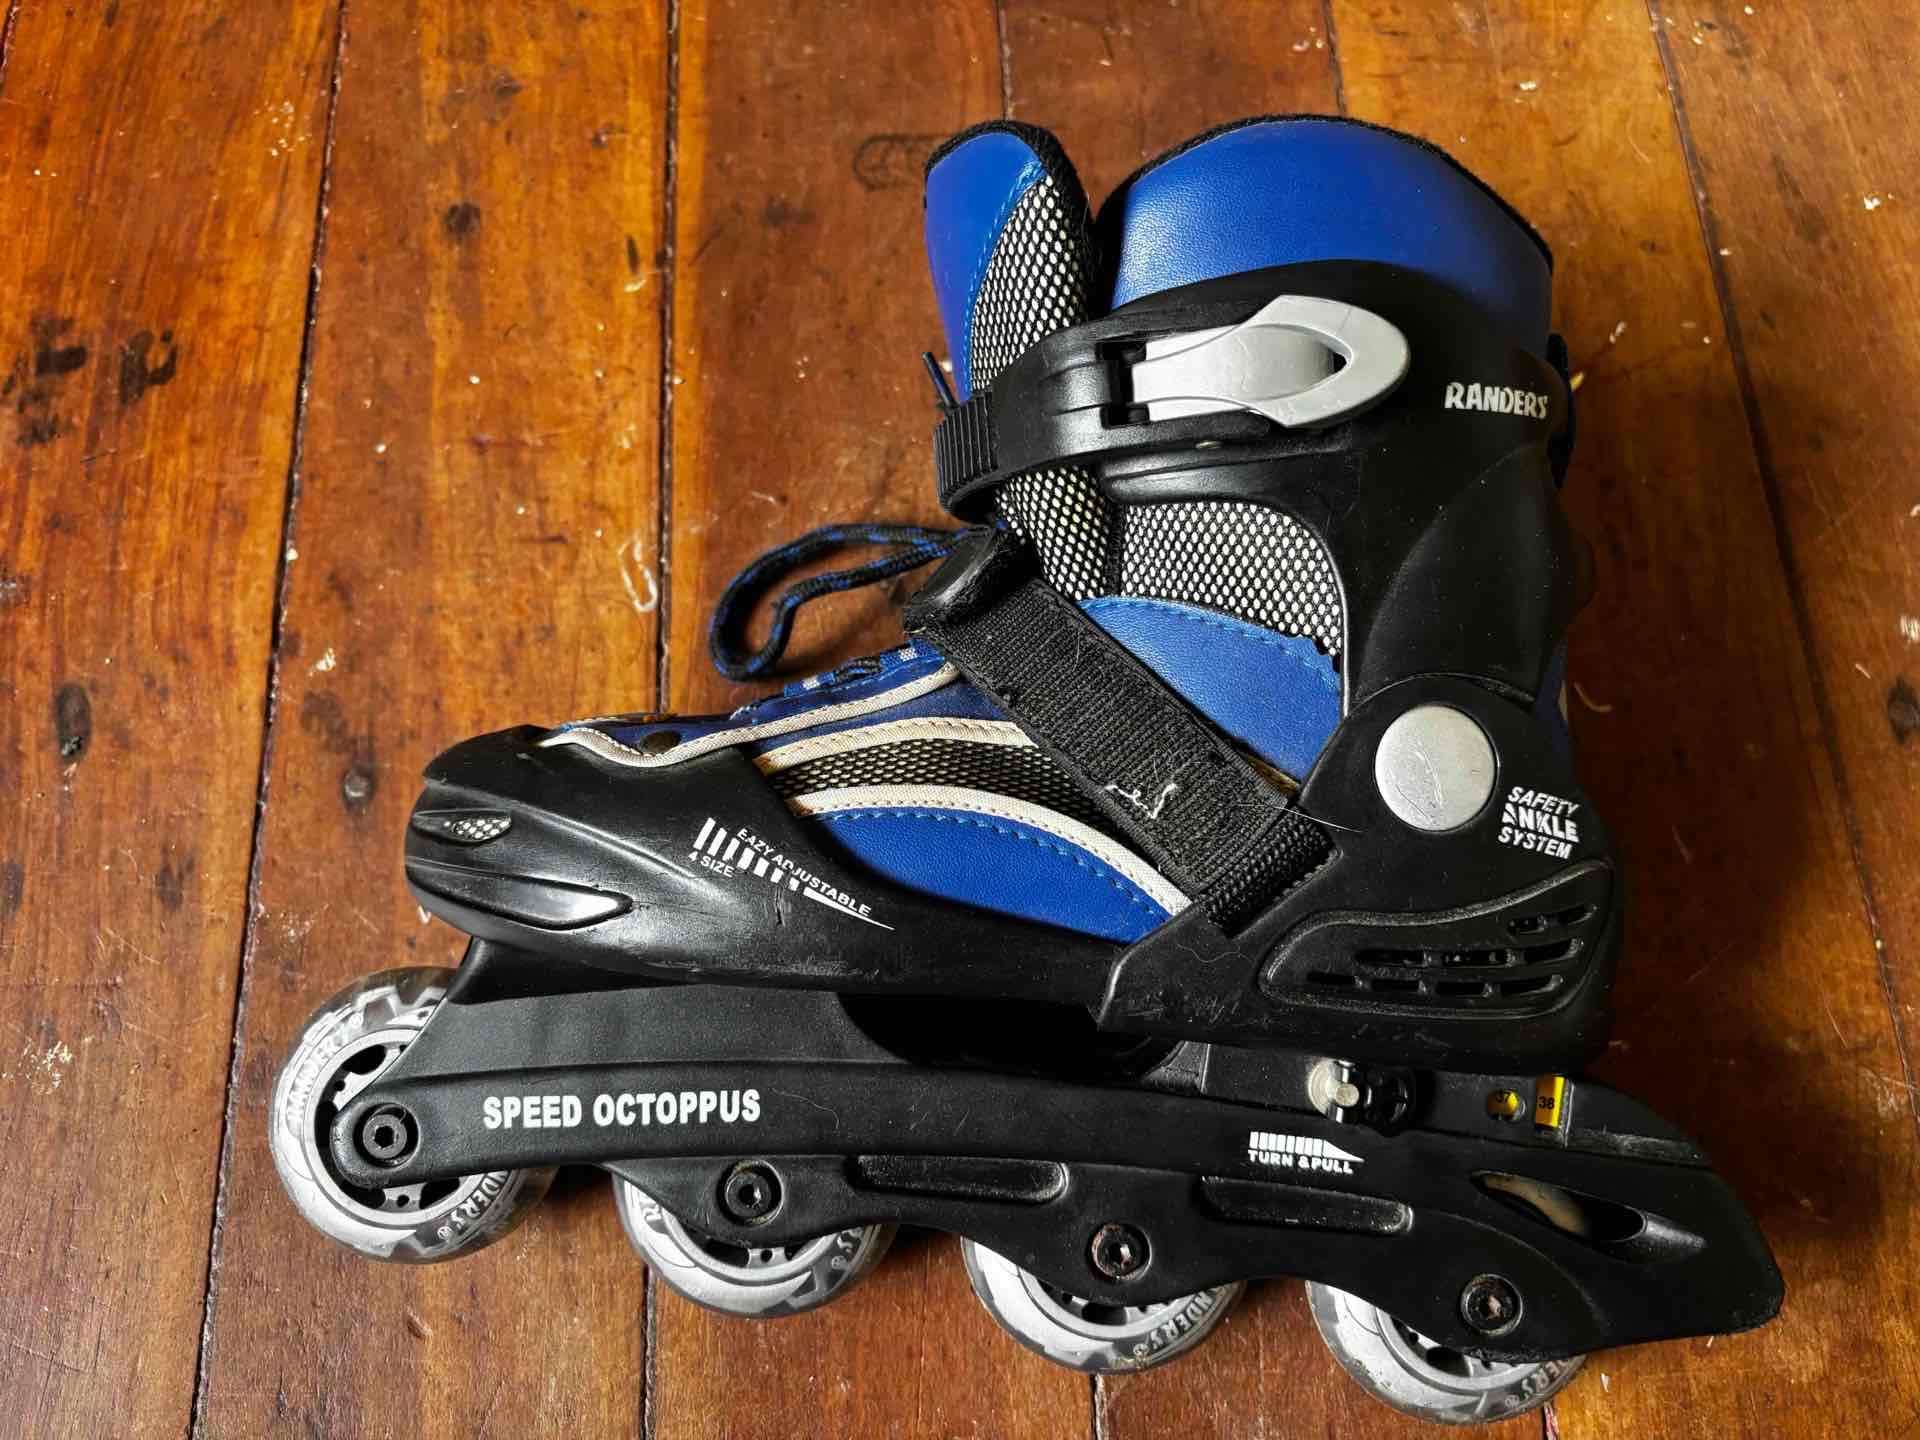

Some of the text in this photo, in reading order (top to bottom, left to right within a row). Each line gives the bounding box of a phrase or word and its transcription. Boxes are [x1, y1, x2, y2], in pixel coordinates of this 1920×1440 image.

[1444, 382, 1548, 419] RANDERS
[1508, 786, 1579, 817] SAFETY
[1502, 803, 1579, 843] ANKLE
[1498, 826, 1572, 859] SYSTEM
[688, 850, 736, 878] 4 SIZE
[736, 828, 872, 916] EAZY ADJUSTABLE
[482, 1089, 761, 1130] SPEED OCTOPPUS
[1538, 1095, 1555, 1110] 38
[1247, 1149, 1294, 1167] TURN
